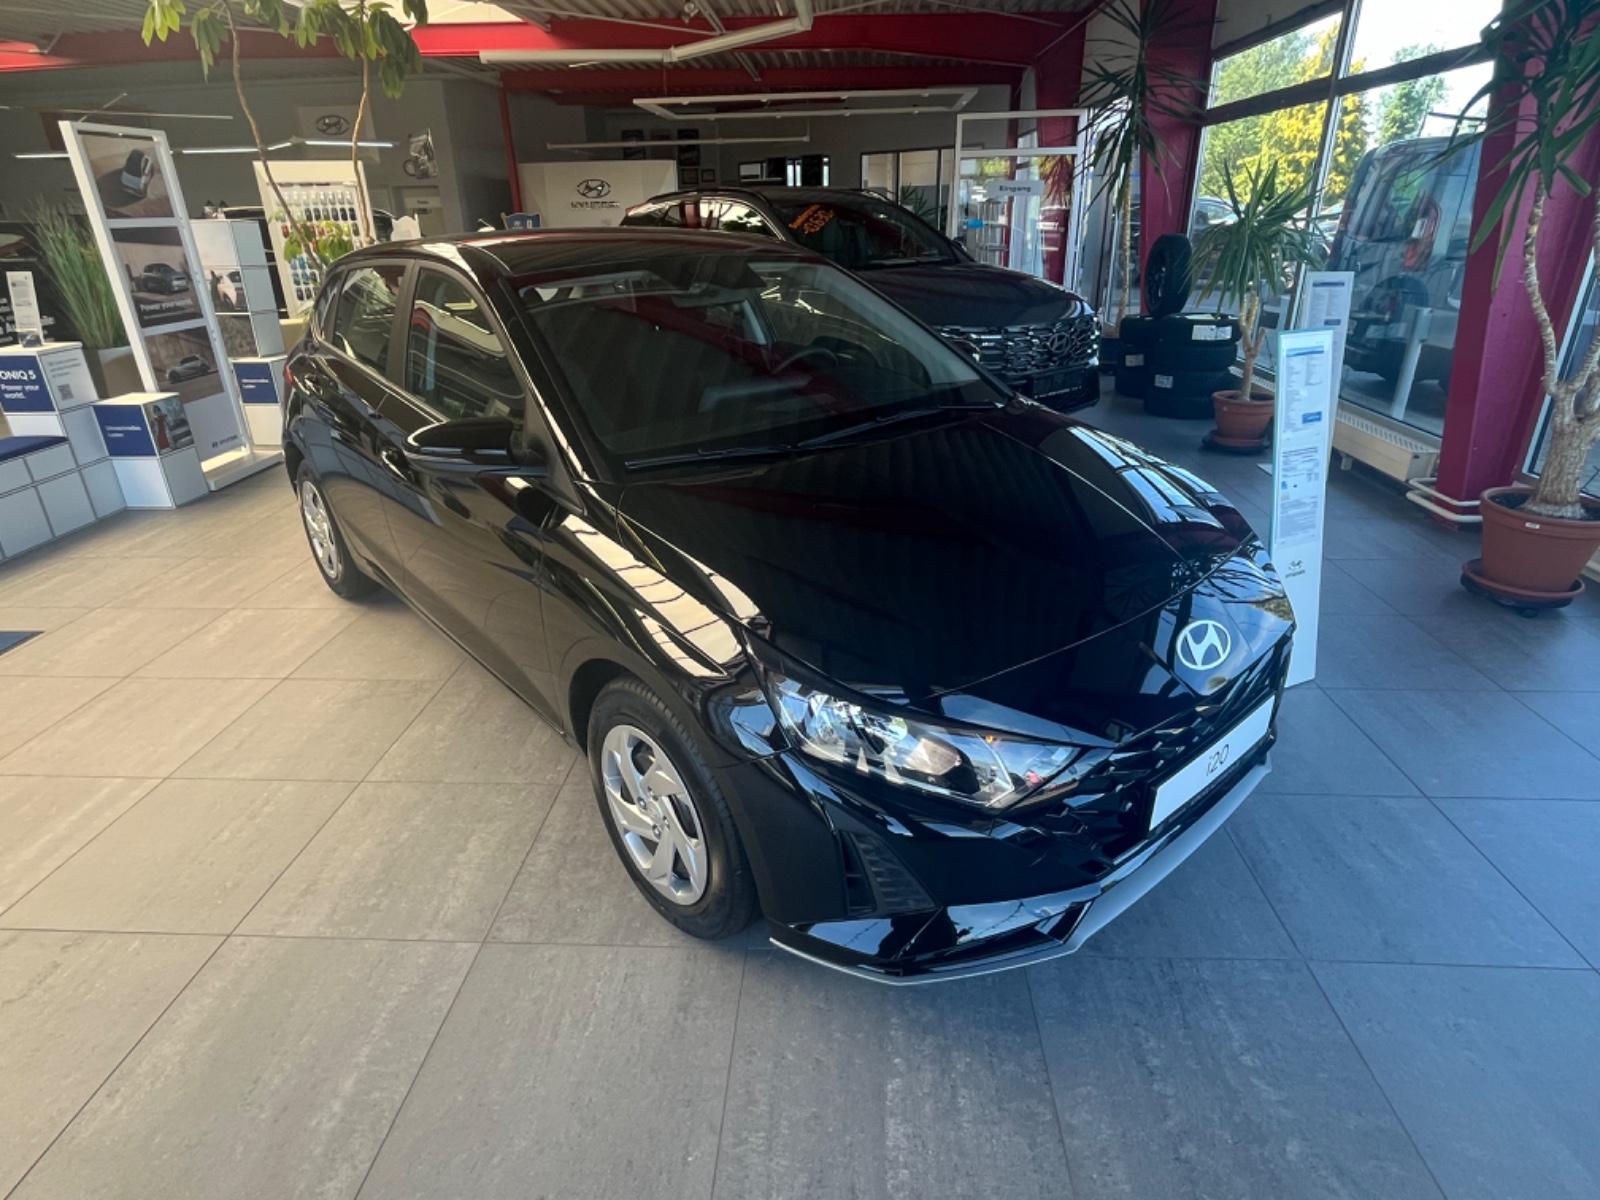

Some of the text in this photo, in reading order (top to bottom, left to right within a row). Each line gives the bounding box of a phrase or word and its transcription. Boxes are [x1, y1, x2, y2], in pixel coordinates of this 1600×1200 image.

[999, 185, 1032, 193] Eingang
[28, 370, 37, 380] 5
[1206, 743, 1230, 777] i20
